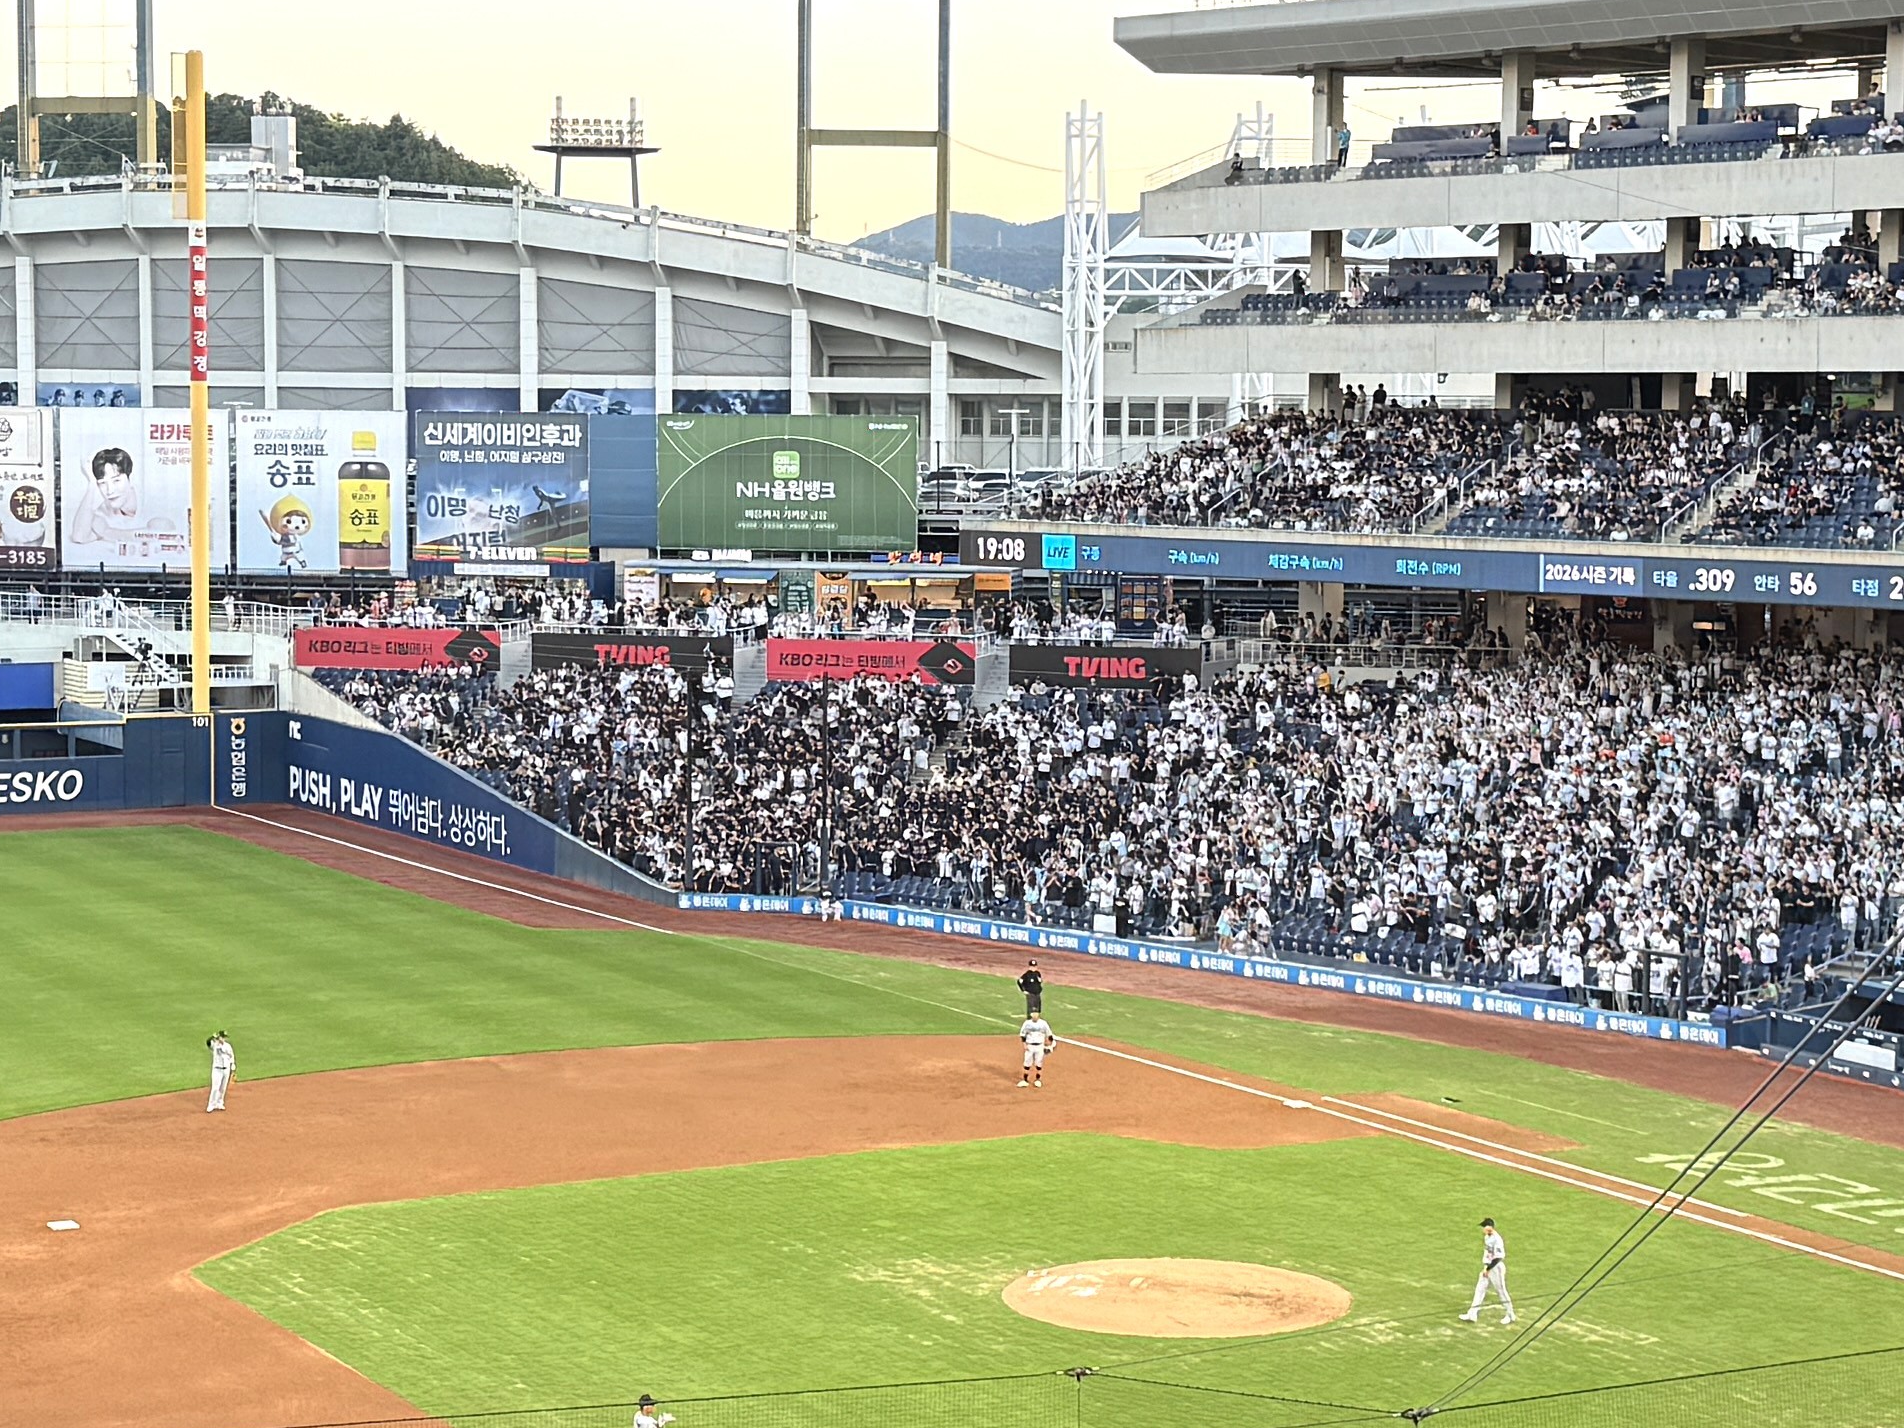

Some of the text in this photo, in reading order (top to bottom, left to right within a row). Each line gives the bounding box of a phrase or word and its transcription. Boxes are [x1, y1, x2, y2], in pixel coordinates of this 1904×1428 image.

[423, 422, 582, 448] 신세계이비인후과
[254, 444, 288, 456] 요리의
[267, 459, 316, 488] 송표
[736, 480, 836, 502] NH올원뱅크
[349, 508, 379, 526] 송표
[426, 495, 467, 518] 이명
[468, 546, 537, 561] 7-ELEVEN
[976, 537, 1025, 561] 19:08
[1047, 546, 1070, 558] LIVE
[1545, 563, 1607, 585] 2026시즌
[1609, 566, 1636, 586] 기록
[1652, 570, 1678, 588] 타율
[1688, 568, 1735, 592] .309
[1754, 572, 1780, 593] 안타
[1789, 572, 1817, 596] 56
[1851, 576, 1879, 597] 타점
[309, 640, 342, 654] KBO
[594, 644, 671, 667] TVING
[780, 653, 813, 667] KBO
[1064, 656, 1147, 679] TVING
[192, 716, 210, 728] 101
[289, 720, 302, 740] NC
[289, 765, 512, 856] PUSH, PLAY 뛰어넘다. 상상하다.
